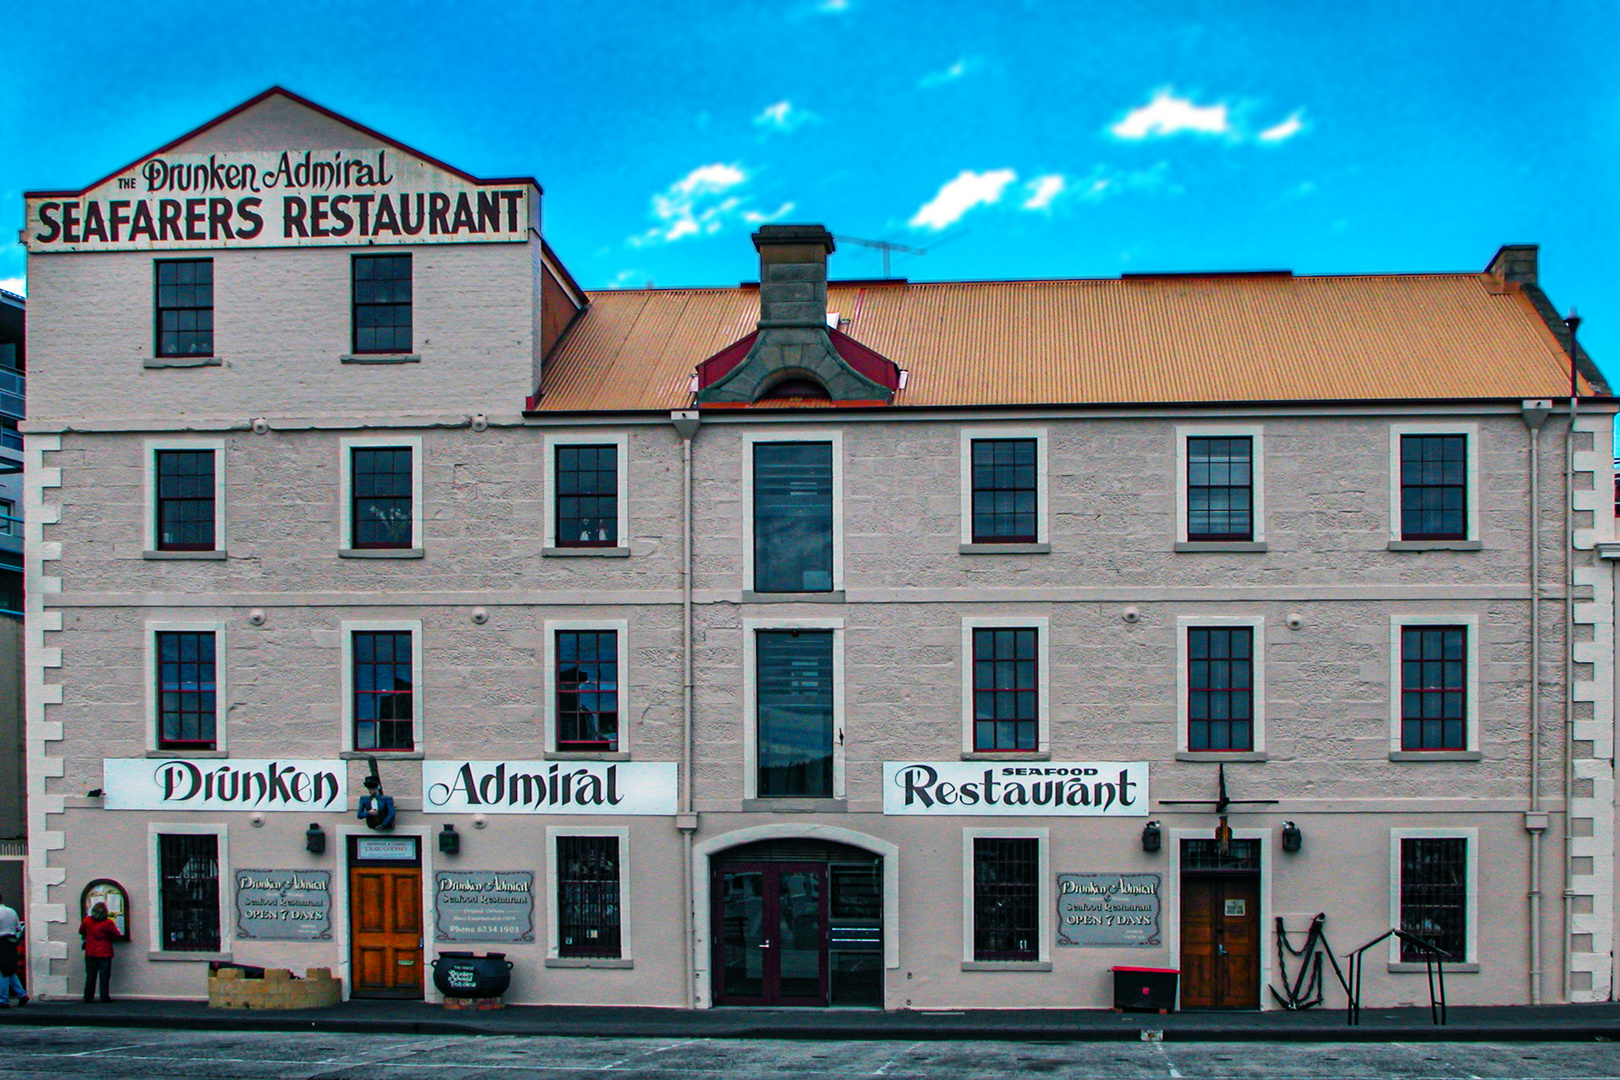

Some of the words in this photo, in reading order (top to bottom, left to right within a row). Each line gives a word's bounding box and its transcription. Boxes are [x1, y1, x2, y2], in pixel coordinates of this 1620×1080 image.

[117, 178, 137, 190] THE
[142, 154, 261, 195] Drunken
[262, 150, 394, 192] Admiral
[36, 196, 264, 244] SEAFARERS
[283, 189, 524, 239] RESTAURANT
[154, 760, 339, 809] Drunken
[428, 762, 625, 811] Admiral
[895, 764, 1137, 812] Restaurant
[1001, 767, 1099, 776] SEAFOOD
[244, 910, 279, 920] OPEN
[280, 909, 289, 921] 7
[291, 911, 323, 920] DAYS
[449, 925, 475, 933] Phone
[1066, 915, 1103, 925] OPEN
[1105, 915, 1115, 926] 7
[1117, 916, 1152, 925] DAYS
